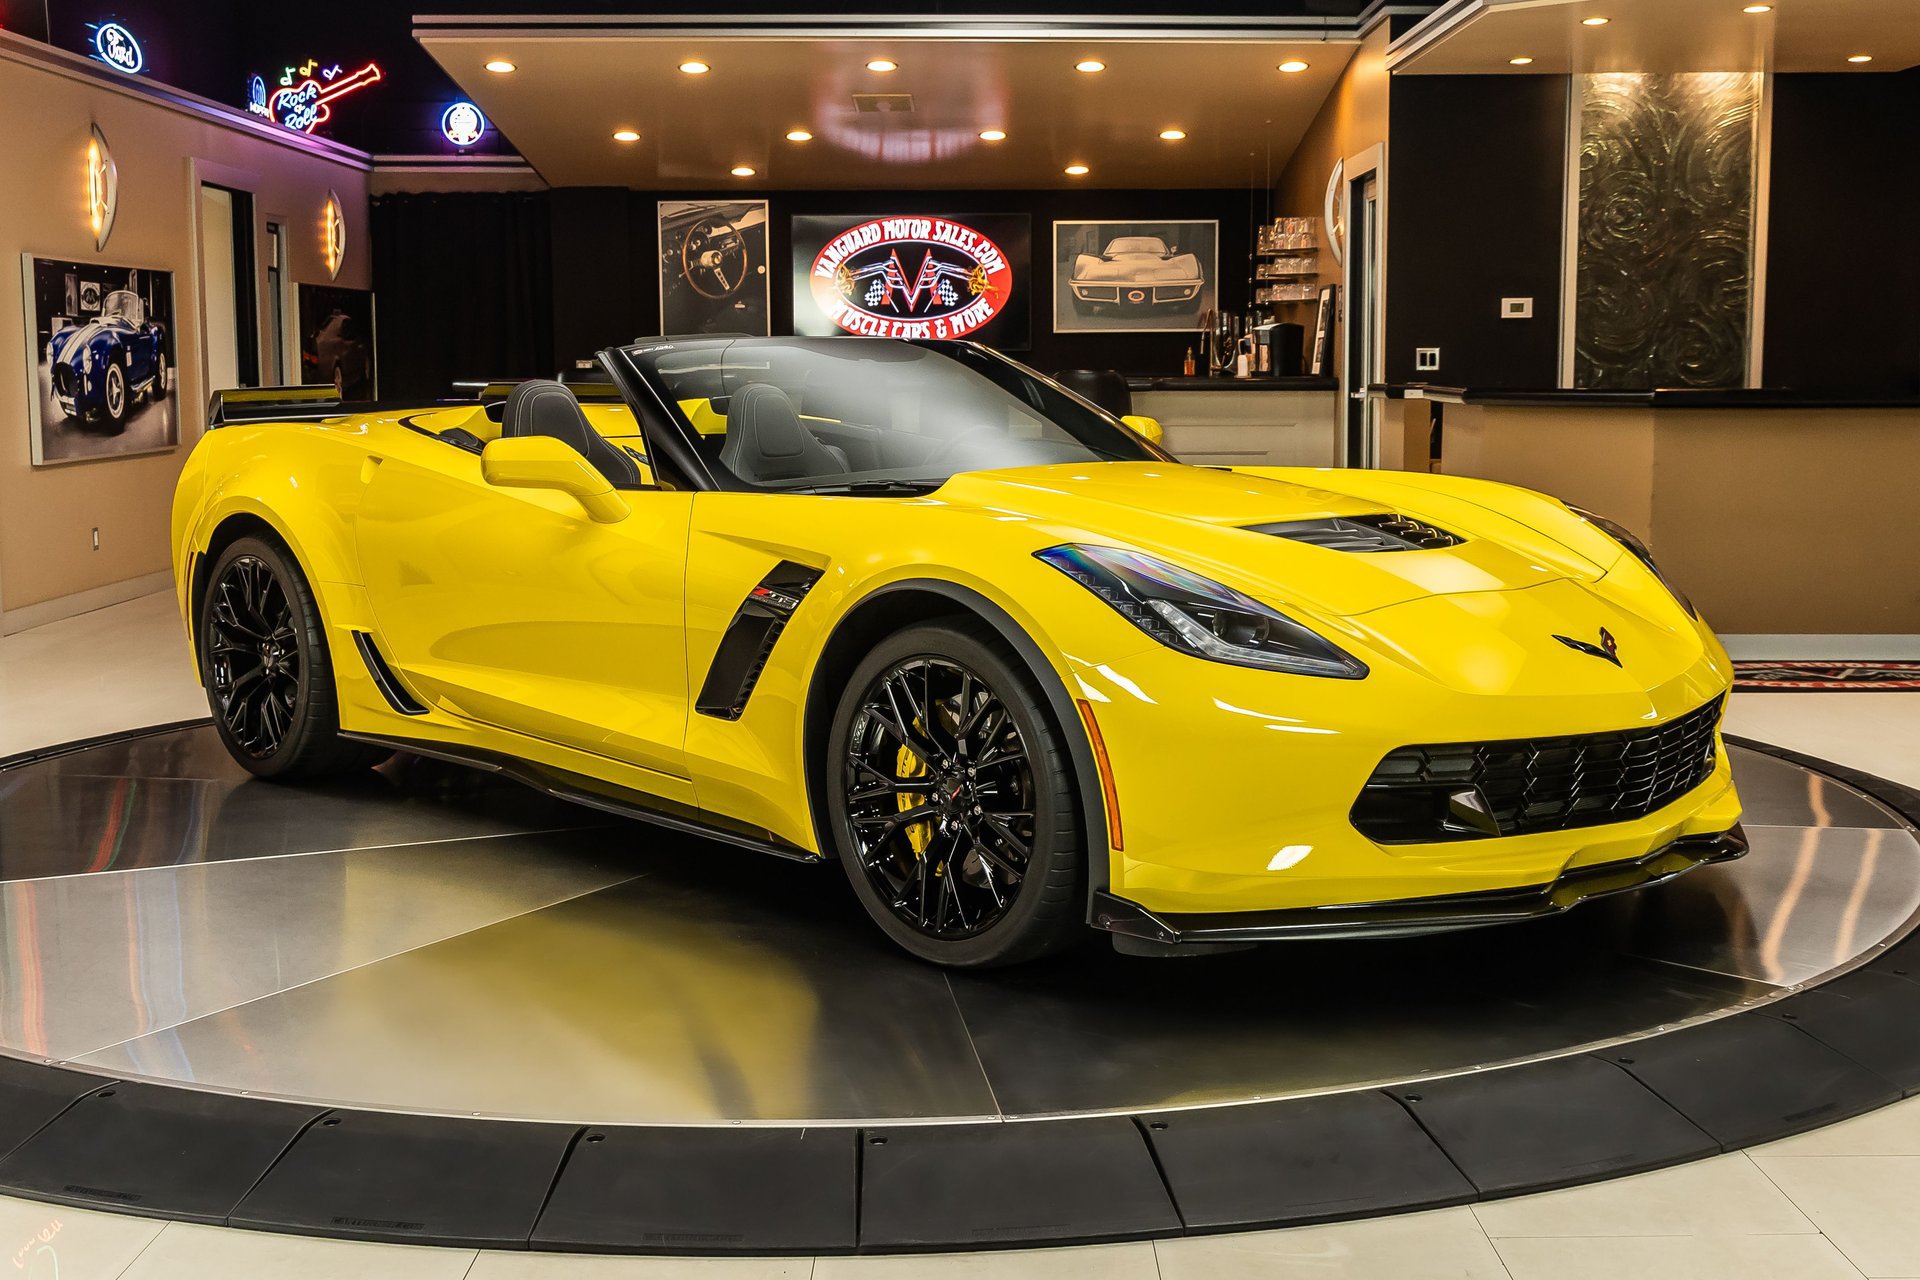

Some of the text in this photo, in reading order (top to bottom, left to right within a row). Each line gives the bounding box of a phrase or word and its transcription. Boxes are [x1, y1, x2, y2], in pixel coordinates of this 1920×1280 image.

[277, 83, 317, 110] Rock
[285, 104, 318, 130] Roll
[814, 223, 882, 279] VANGUARD
[882, 219, 932, 241] MOTOR
[891, 320, 931, 339] CARS
[934, 319, 948, 339] &
[948, 297, 994, 335] MORE
